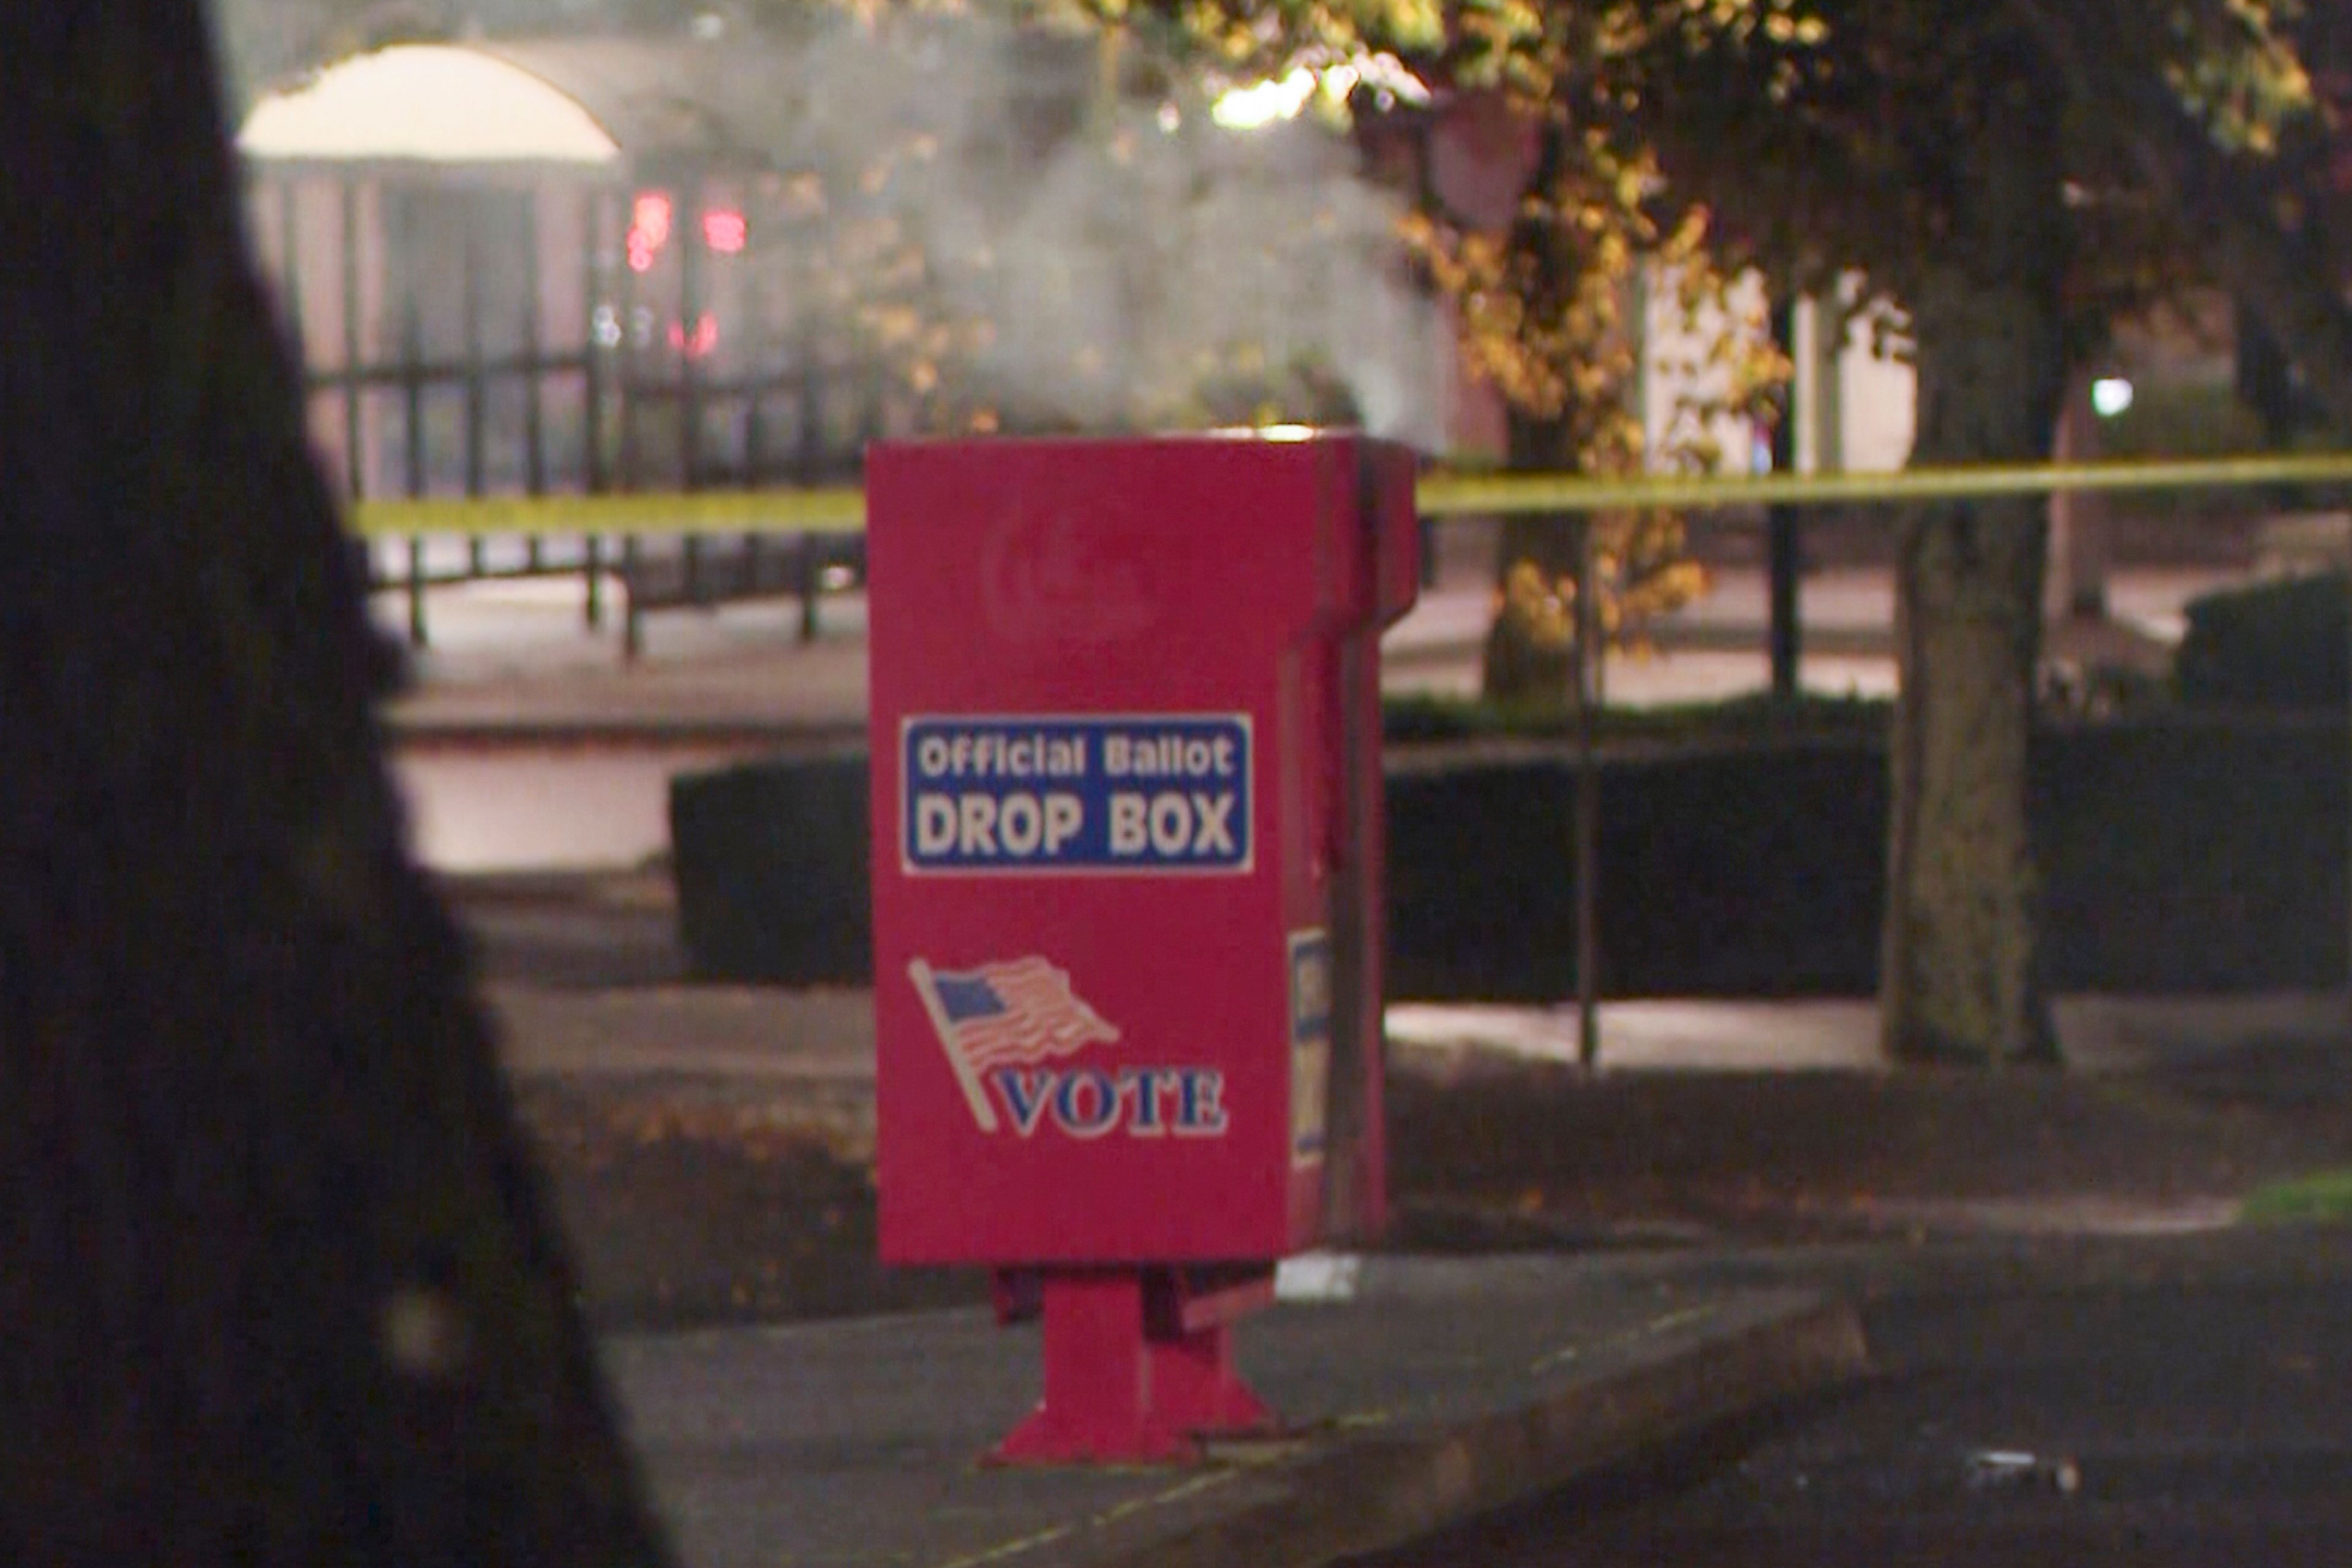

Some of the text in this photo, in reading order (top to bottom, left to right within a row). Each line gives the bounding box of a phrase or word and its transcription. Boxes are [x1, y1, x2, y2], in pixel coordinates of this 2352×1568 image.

[919, 734, 1234, 777] Official Ballot
[918, 794, 1234, 856] DROP BOX
[993, 1066, 1229, 1138] VOTE
